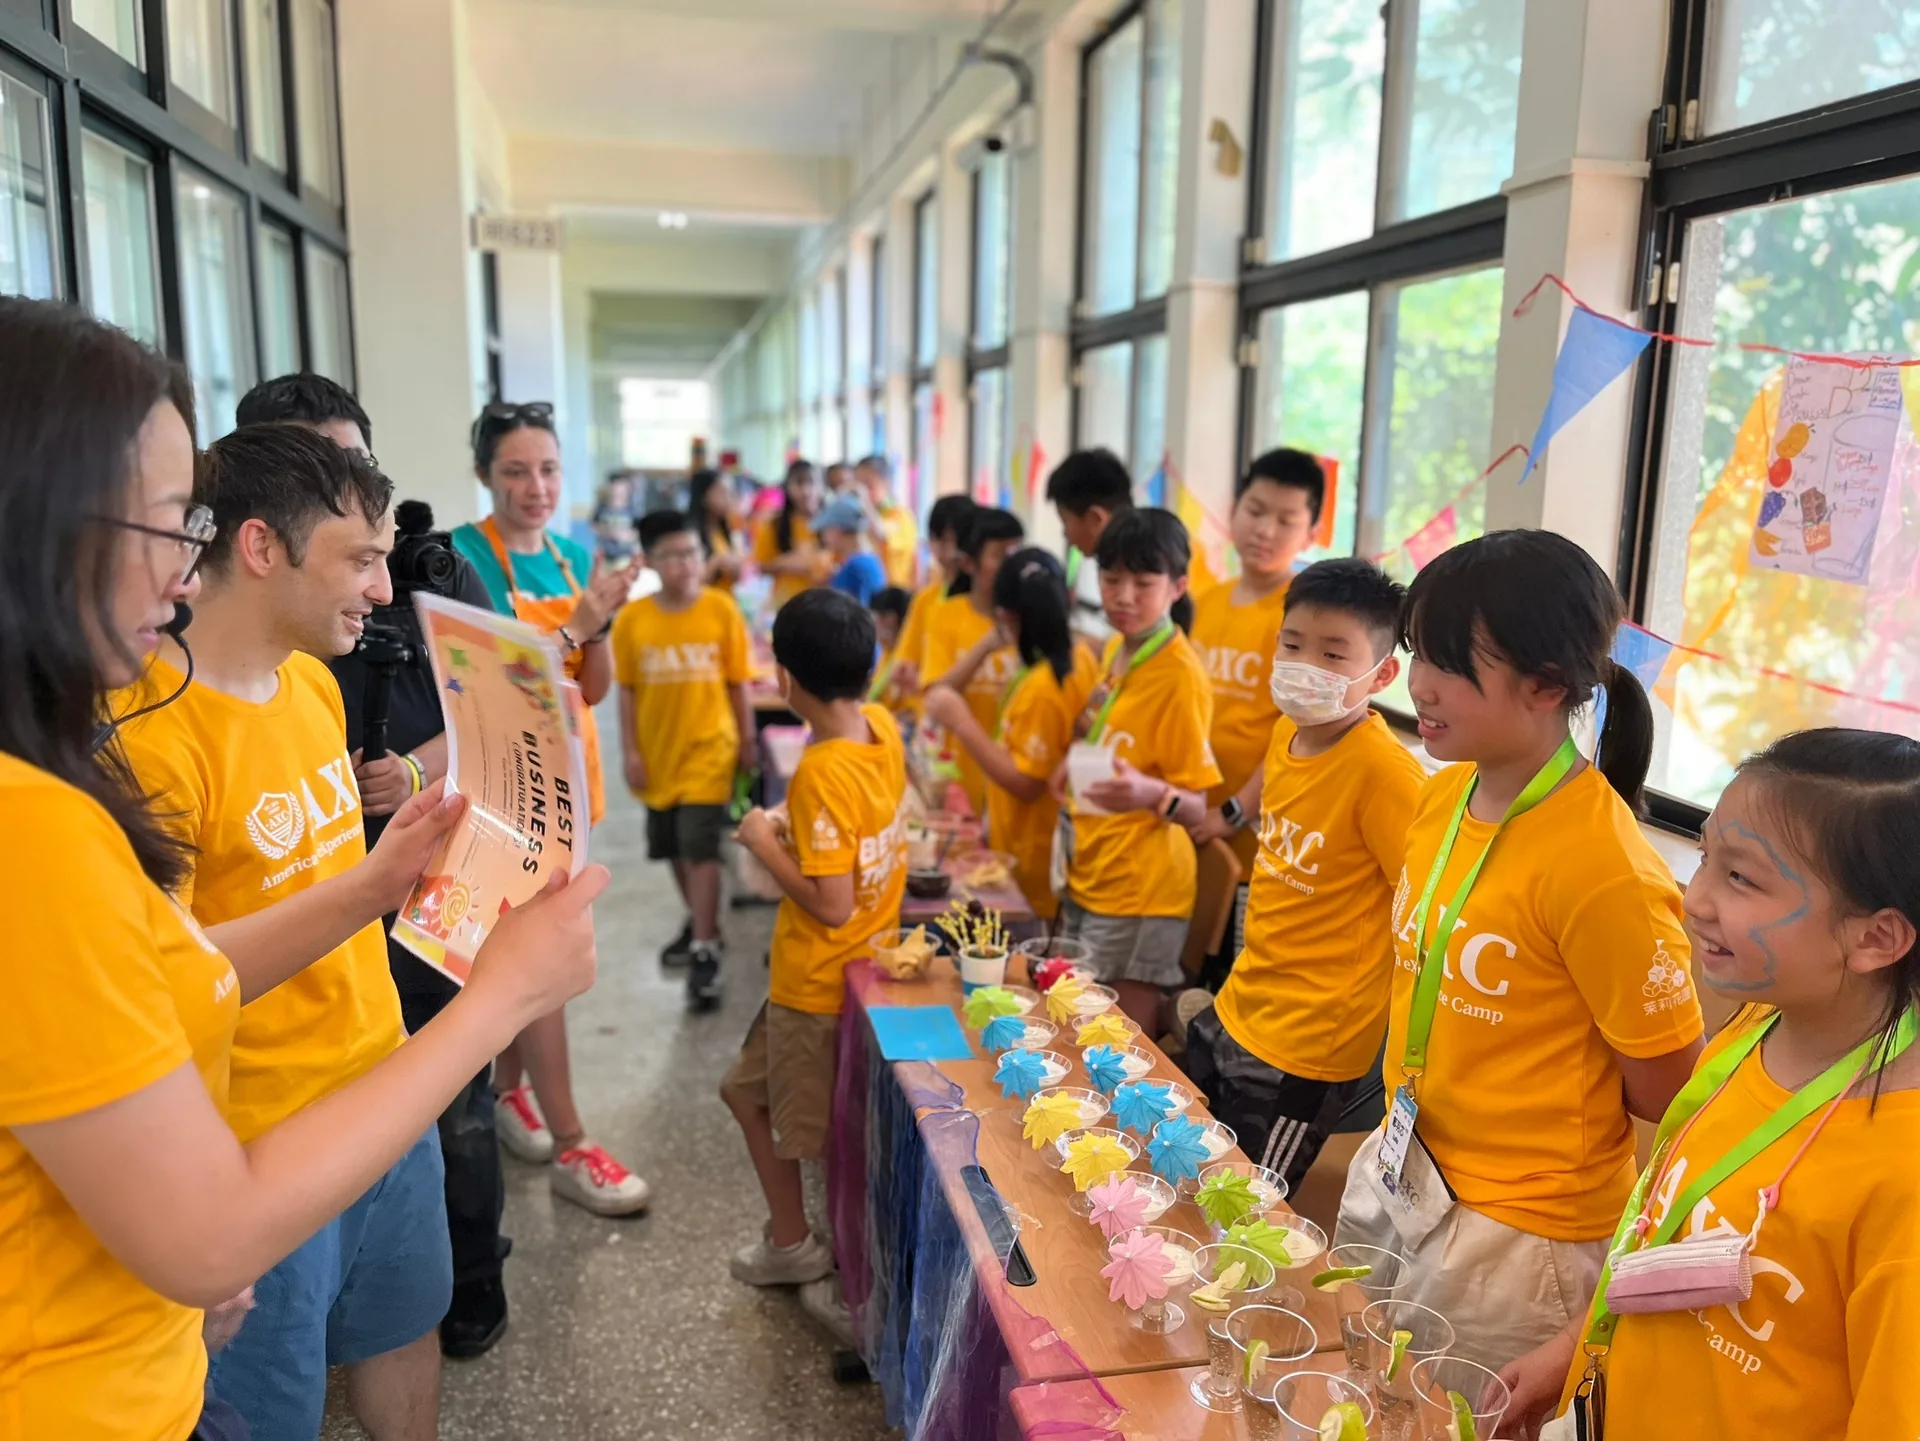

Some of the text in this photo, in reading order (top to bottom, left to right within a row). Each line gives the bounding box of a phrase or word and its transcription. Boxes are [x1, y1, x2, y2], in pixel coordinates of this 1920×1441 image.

[299, 748, 362, 831] AX
[521, 730, 546, 875] BUSINESS
[552, 776, 573, 853] BEST
[1284, 873, 1315, 896] Camp
[1451, 996, 1504, 1026] Camp
